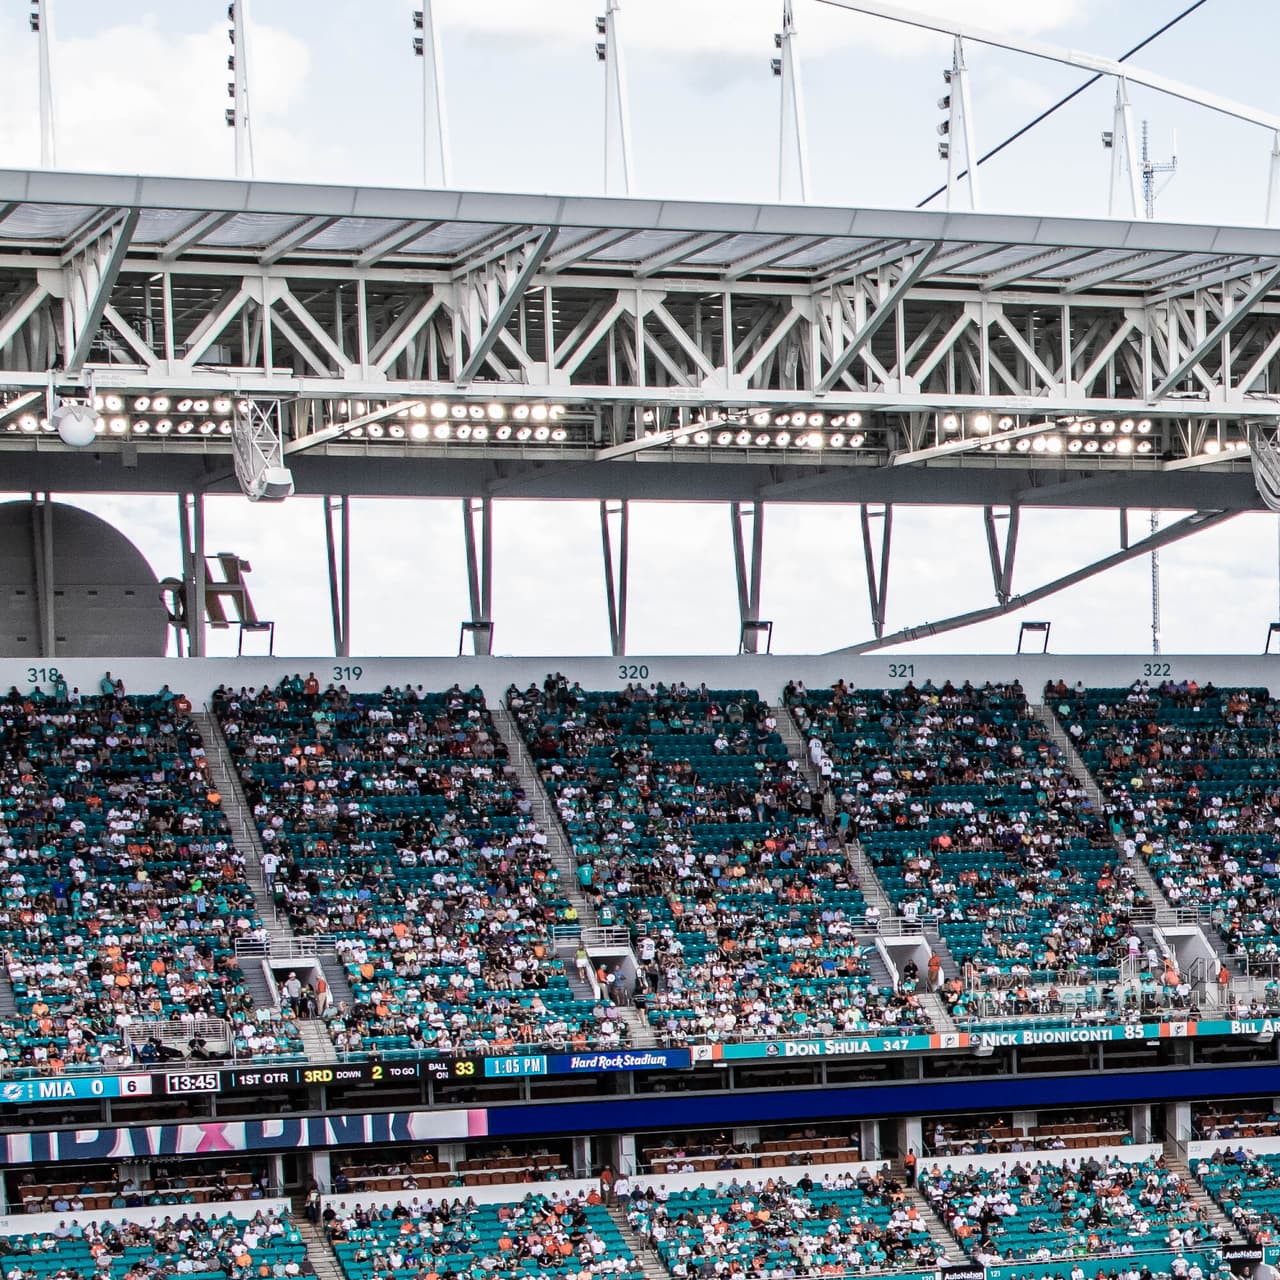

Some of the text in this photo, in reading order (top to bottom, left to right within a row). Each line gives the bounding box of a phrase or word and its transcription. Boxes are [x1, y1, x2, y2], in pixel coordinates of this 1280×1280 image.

[28, 668, 58, 682] 318
[332, 666, 362, 681] 319
[618, 665, 649, 679] 320
[888, 664, 915, 678] 321
[1143, 663, 1171, 678] 322
[1232, 1020, 1260, 1035] BILL
[983, 1024, 1145, 1047] NICK BUONICONTI 85
[786, 1039, 909, 1056] DON SHULA 347
[571, 1055, 599, 1069] Hard
[623, 1054, 667, 1068] Stadium
[39, 1058, 541, 1098] MIA 0 6 13:45 1ST QTR 3RD DOWN 2 TO GO BALL 33 1:05 PM
[437, 1071, 449, 1080] ON
[944, 1271, 984, 1280] AutoNation
[990, 1270, 1001, 1278] 121
